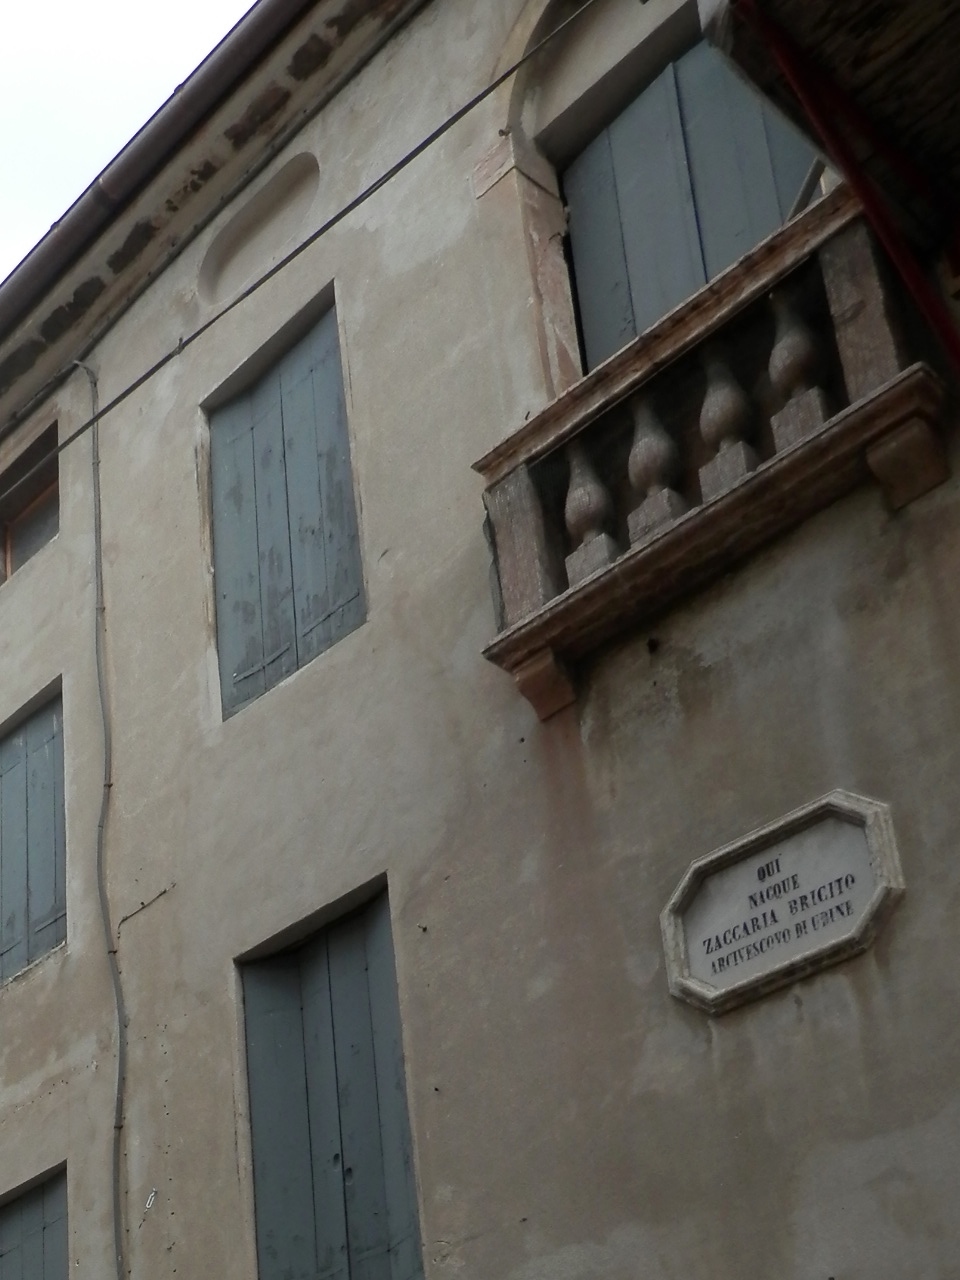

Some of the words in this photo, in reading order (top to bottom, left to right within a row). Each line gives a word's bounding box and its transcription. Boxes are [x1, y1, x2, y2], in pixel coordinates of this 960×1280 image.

[748, 873, 800, 910] NACQUE
[757, 858, 781, 882] QUI
[702, 909, 779, 955] ZACCARIA
[788, 873, 856, 916] BRICITO
[710, 928, 791, 974] ARCIVESCOVO
[794, 919, 809, 939] DI
[811, 900, 854, 931] UDINE
